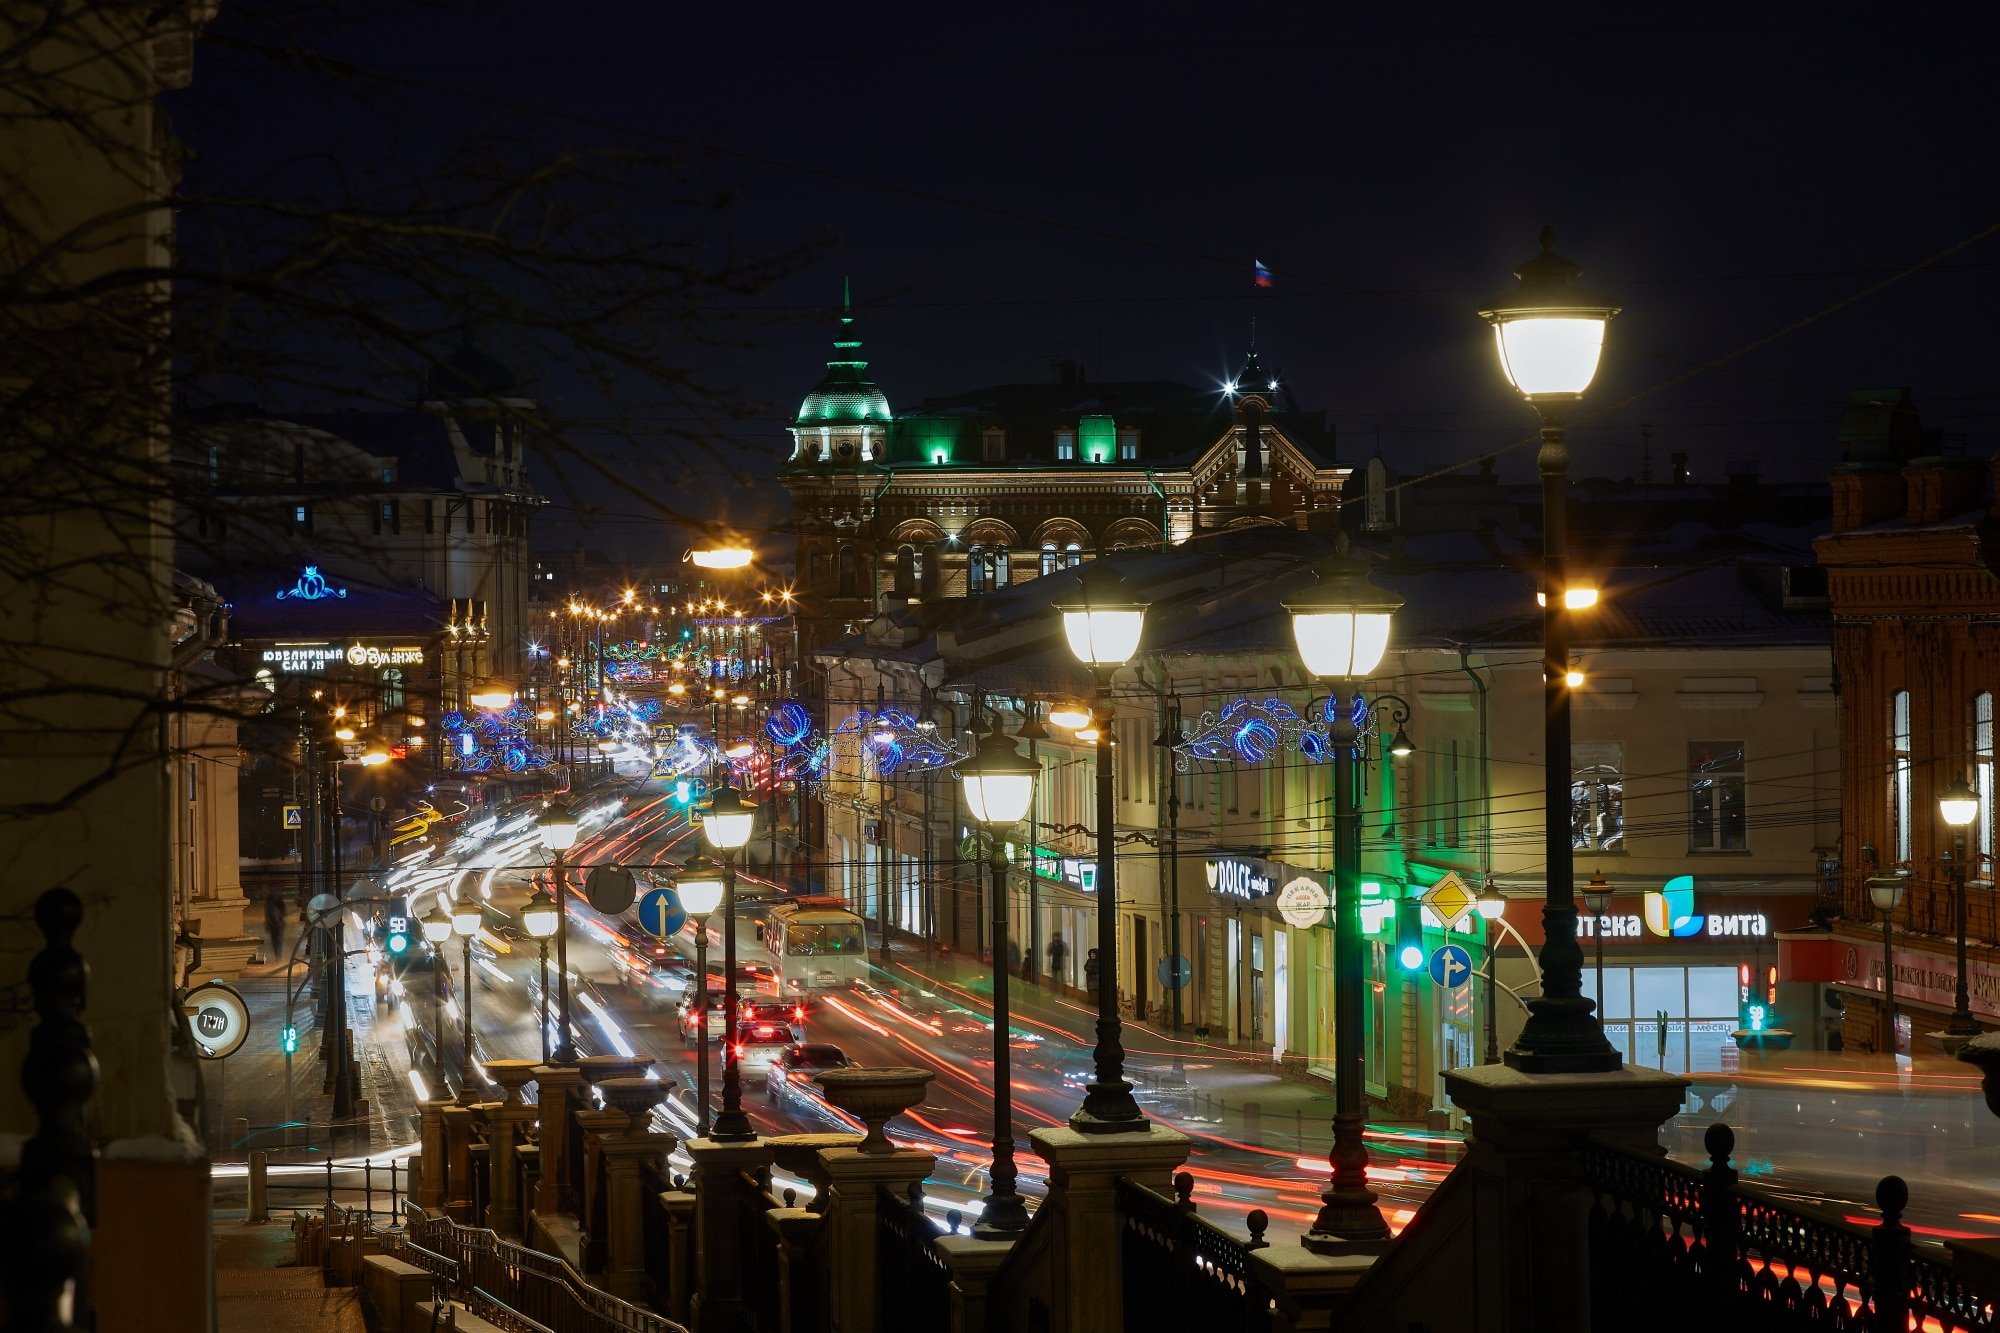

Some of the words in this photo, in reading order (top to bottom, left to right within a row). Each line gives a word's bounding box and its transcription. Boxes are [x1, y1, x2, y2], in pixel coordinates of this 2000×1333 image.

[263, 649, 344, 661] ЮВЕЛИРНЫЙ
[1218, 860, 1250, 900] DOLCE
[1286, 886, 1319, 899] ПЕКАРНЯ
[1576, 915, 1641, 937] птека
[1708, 914, 1766, 936] вита
[1638, 1021, 1682, 1032] кажый
[1697, 1023, 1731, 1033] месяц
